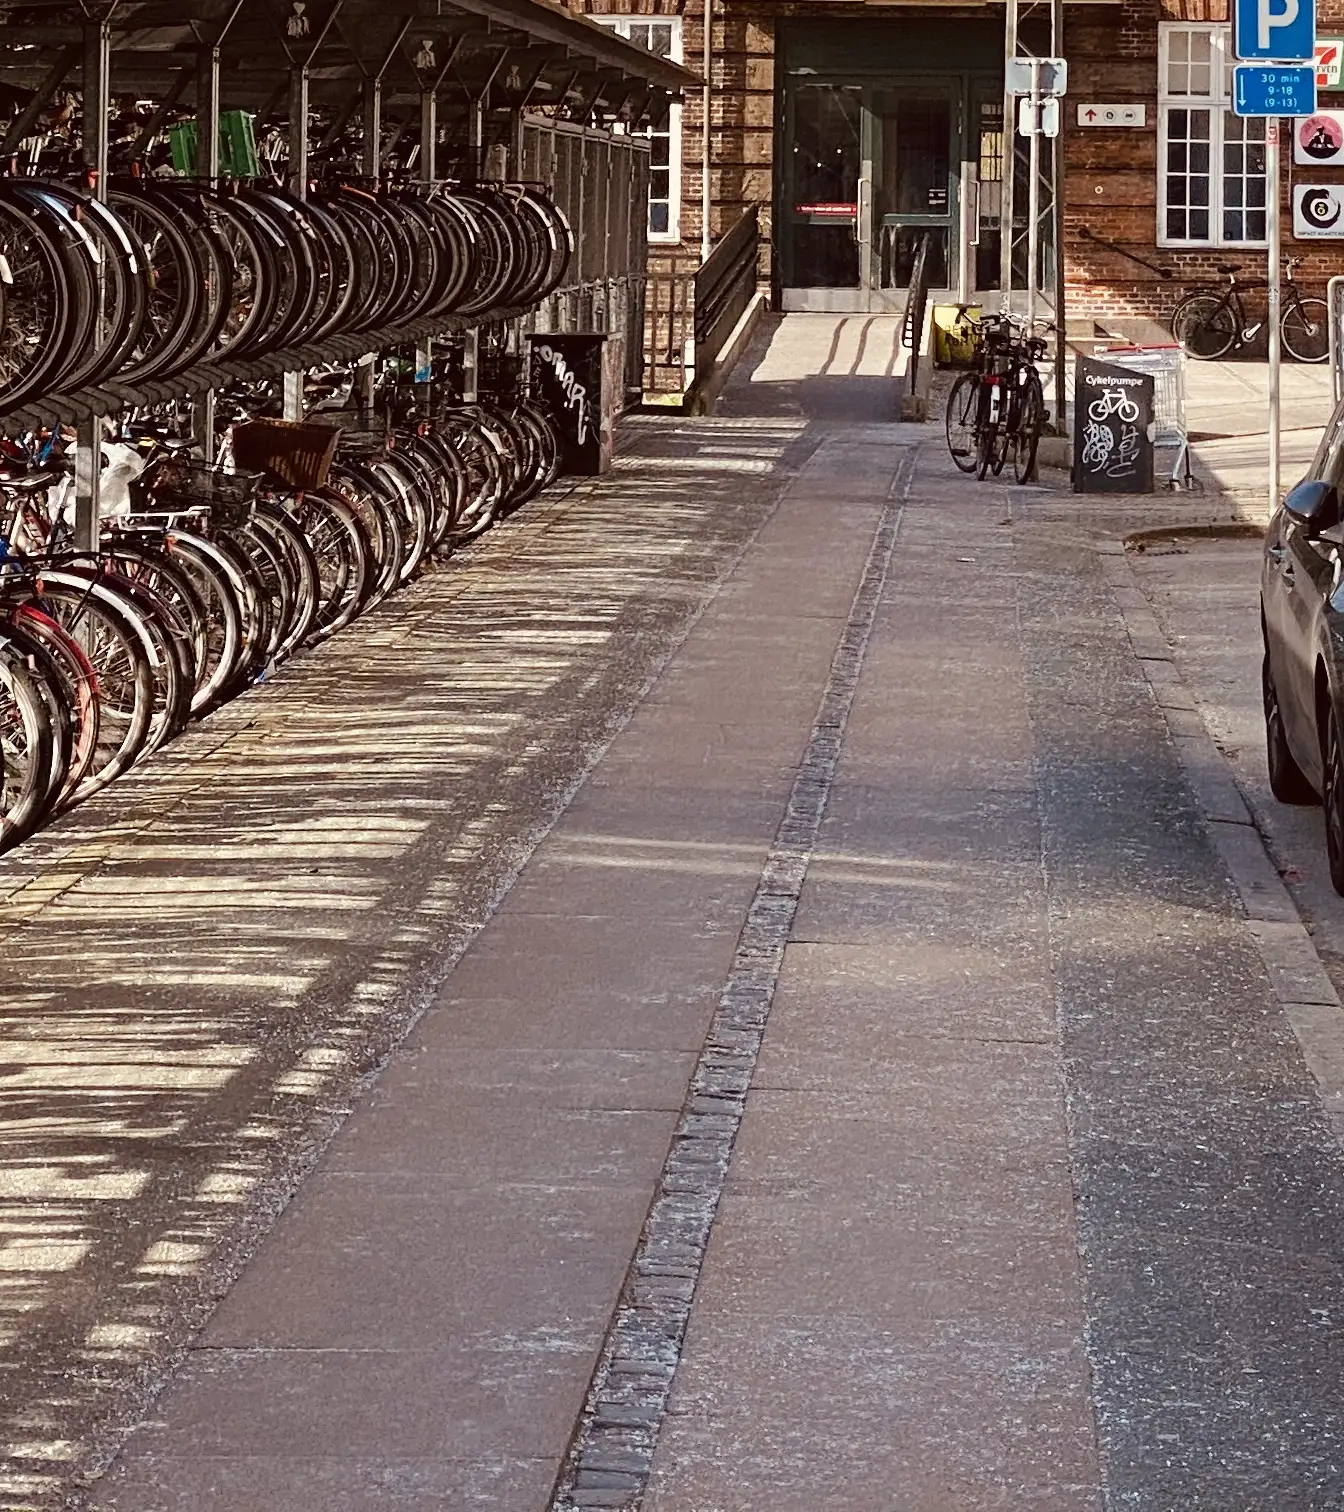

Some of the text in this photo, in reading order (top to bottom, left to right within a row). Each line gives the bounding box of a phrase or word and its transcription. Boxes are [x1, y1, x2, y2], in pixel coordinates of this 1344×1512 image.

[1261, 73, 1300, 83] 30 min
[1268, 86, 1293, 95] 9-18
[1265, 97, 1297, 107] (9-13)
[1085, 375, 1144, 386] Cykelpumpe
